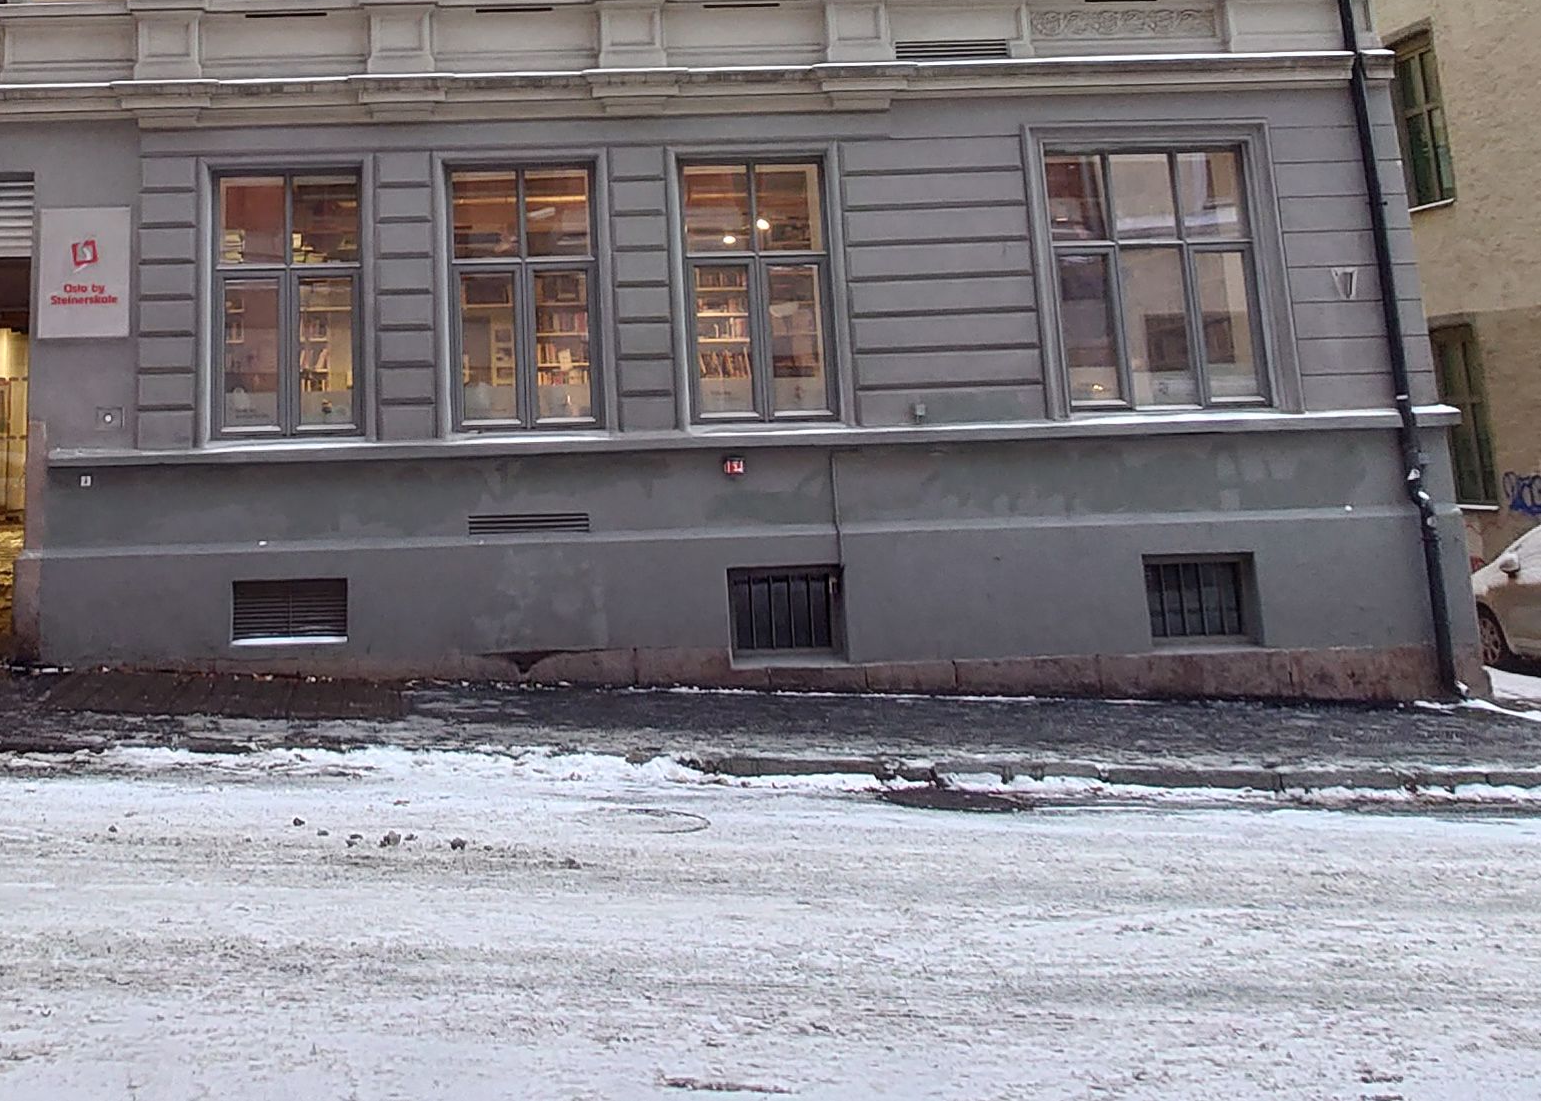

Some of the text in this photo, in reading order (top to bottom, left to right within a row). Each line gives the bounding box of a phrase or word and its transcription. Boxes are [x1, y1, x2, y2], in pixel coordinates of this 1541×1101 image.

[63, 283, 106, 295] Oslo by
[50, 295, 118, 305] Steinerskole
